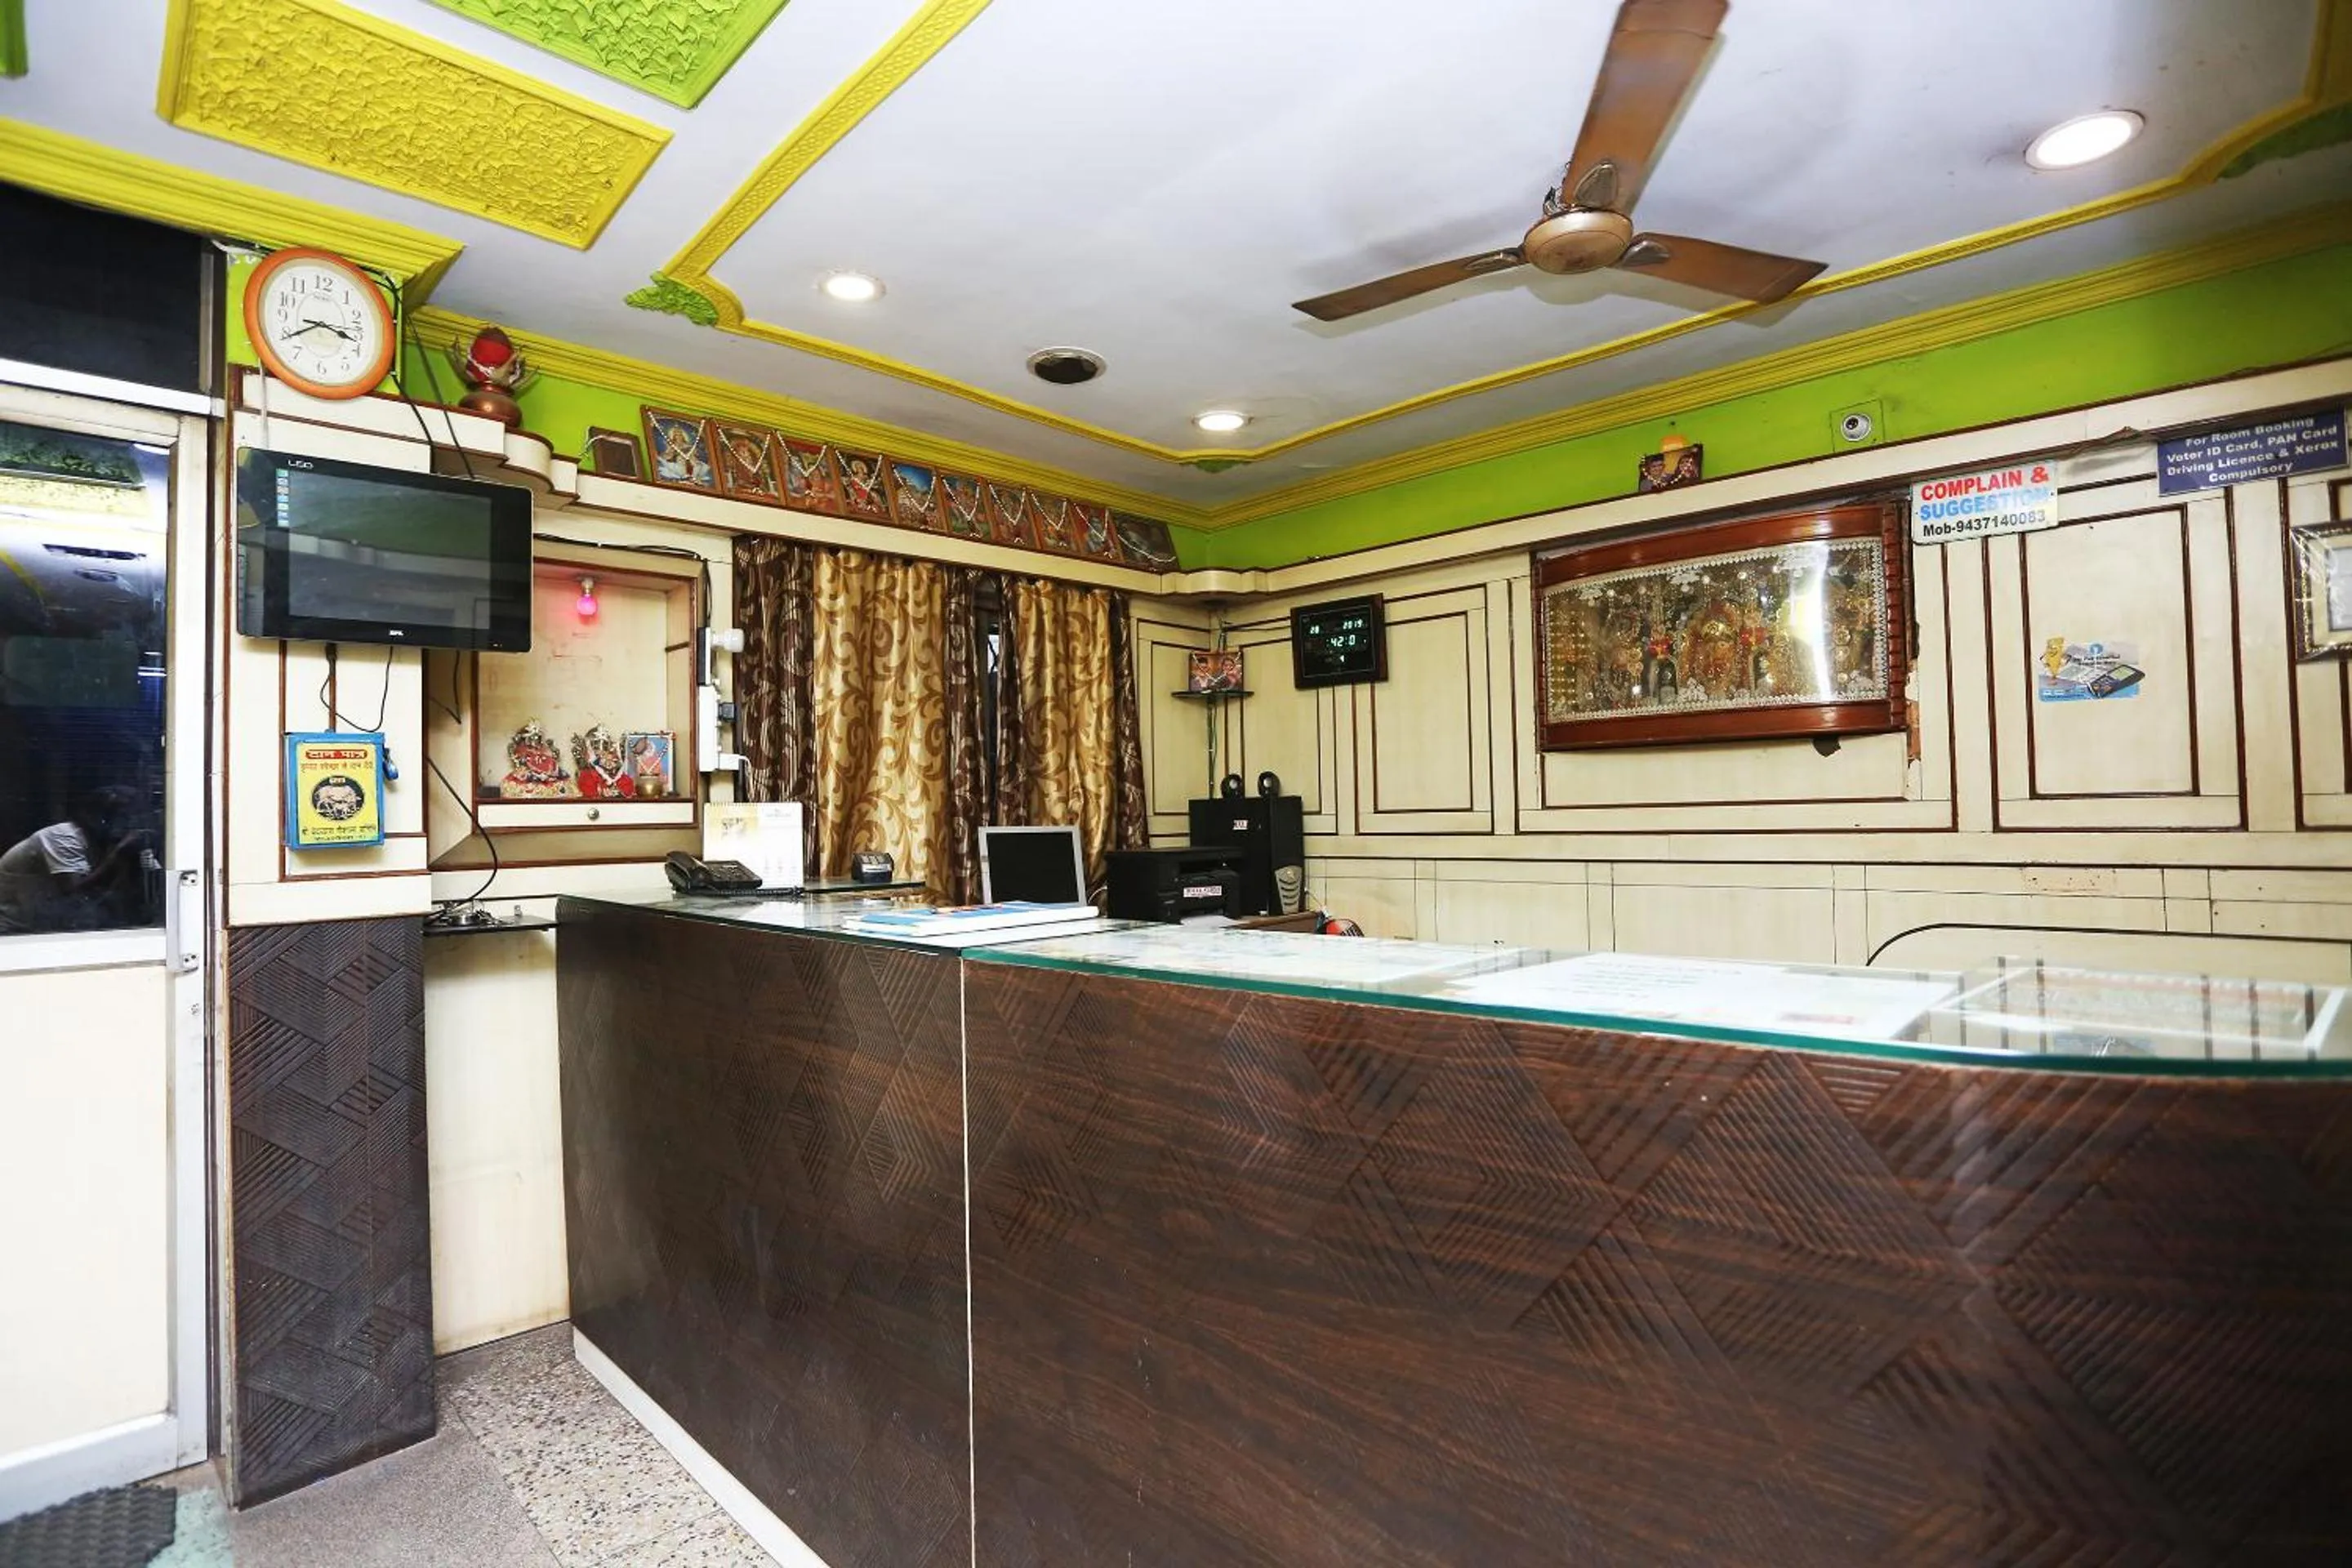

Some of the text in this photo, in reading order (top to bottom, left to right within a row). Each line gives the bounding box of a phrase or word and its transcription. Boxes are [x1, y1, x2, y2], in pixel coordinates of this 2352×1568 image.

[292, 277, 305, 294] 11
[315, 274, 333, 292] 12
[279, 292, 296, 308] 10
[343, 290, 350, 305] 1
[278, 308, 287, 323] 9
[352, 310, 361, 324] 2
[292, 345, 302, 360] 7
[316, 361, 327, 375] 6
[341, 356, 350, 372] 5
[2185, 416, 2314, 448] For Room Booking
[2167, 425, 2337, 463] Voter ID Card, PAN Card
[288, 459, 314, 470] LED
[2167, 440, 2339, 476] Driving Licence & Xerox
[2208, 461, 2293, 483] Compulsory
[1921, 466, 2049, 501] COMPLAIN &
[1921, 488, 2048, 521] SUGGESTION
[1923, 510, 2046, 537] Mob-9437140083
